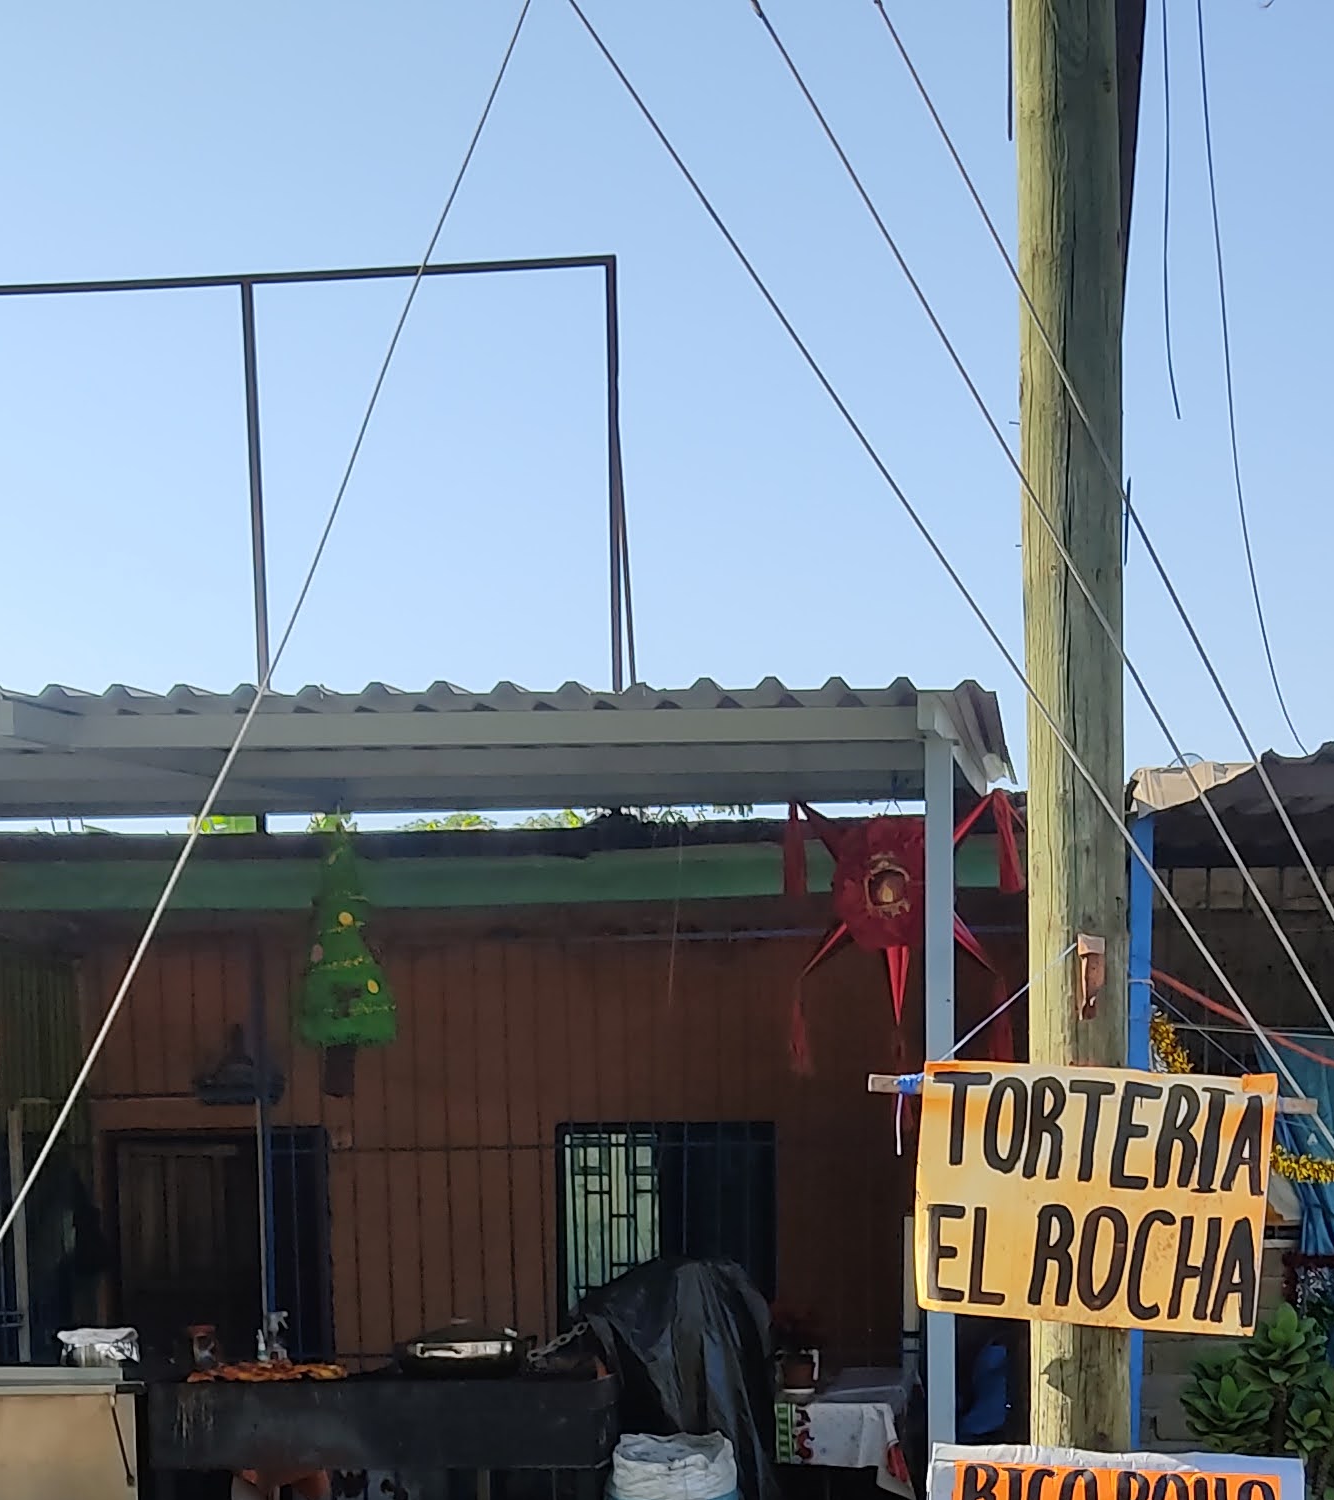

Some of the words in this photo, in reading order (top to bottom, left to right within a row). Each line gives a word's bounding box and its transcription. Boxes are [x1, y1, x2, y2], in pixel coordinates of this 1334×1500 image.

[932, 1071, 1265, 1196] TORTERIA
[927, 1203, 1006, 1307] EL
[1028, 1203, 1257, 1328] ROCHA
